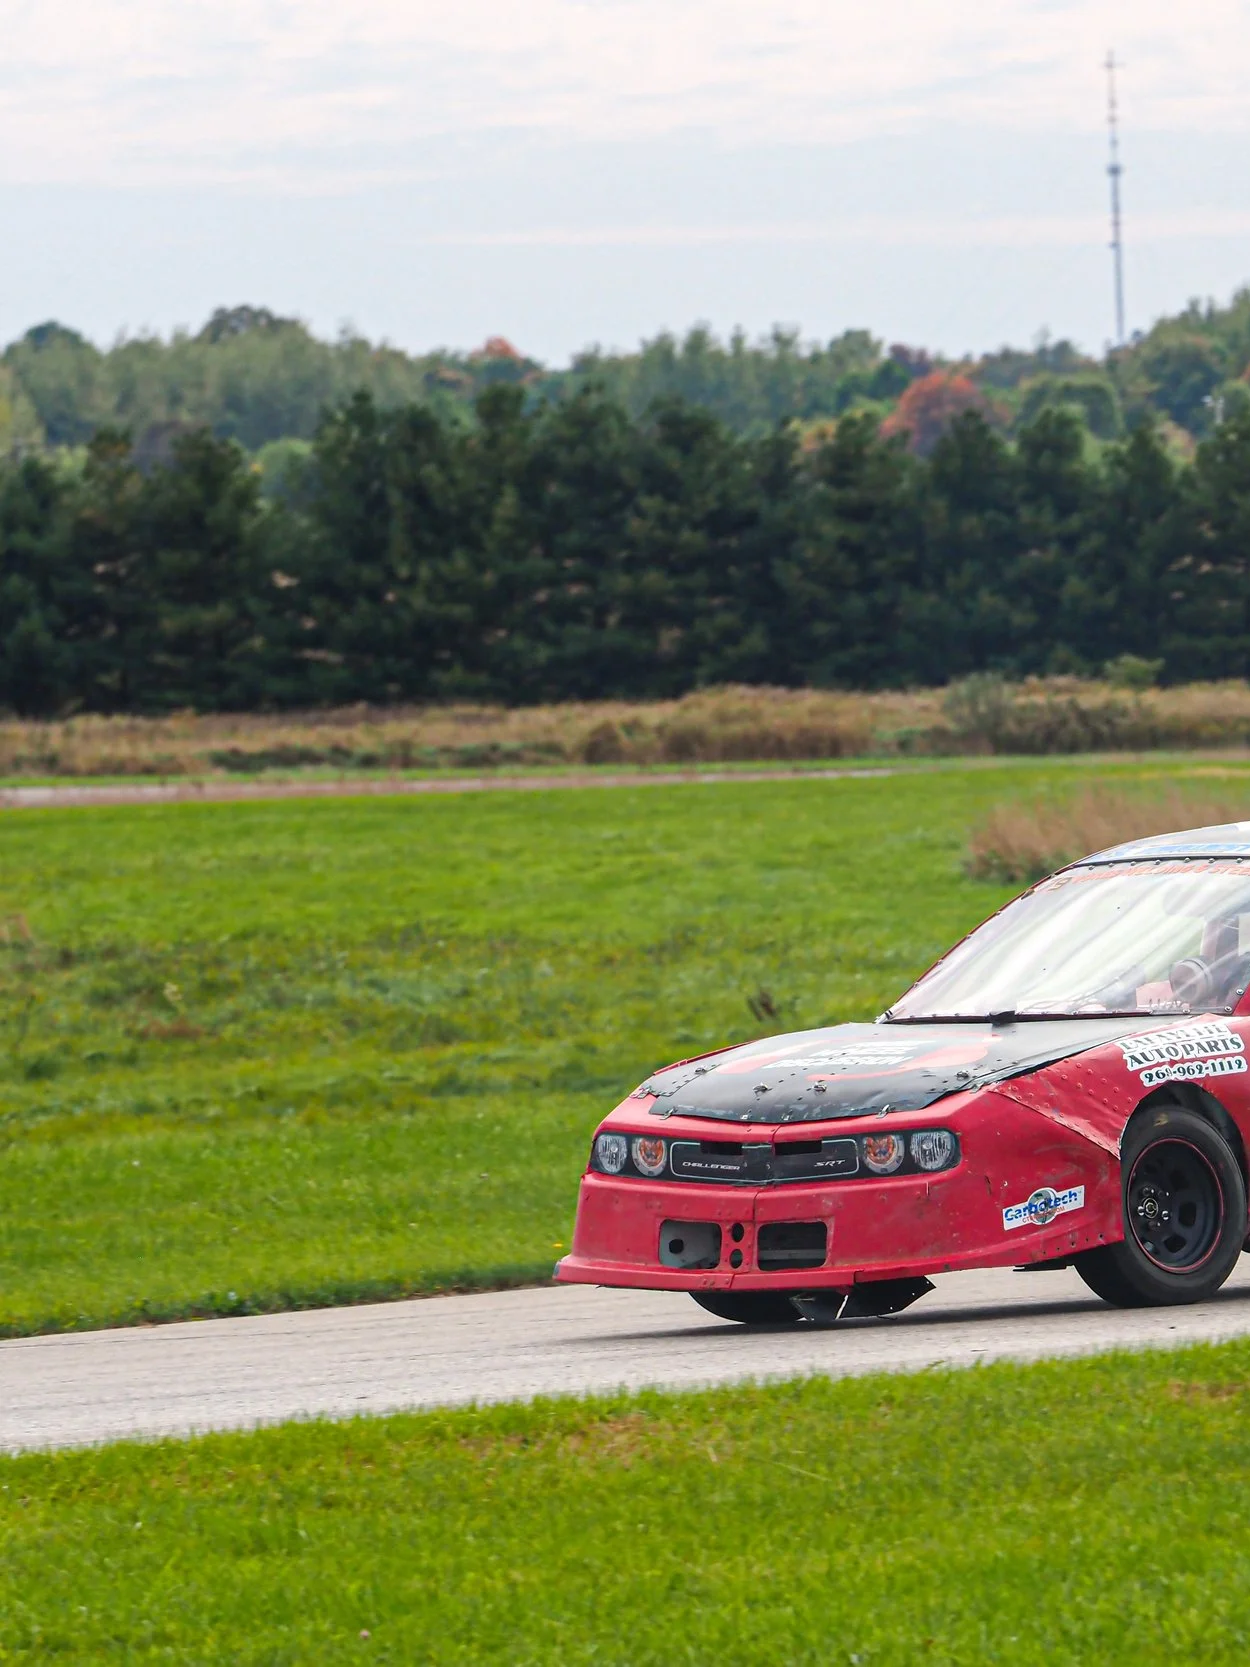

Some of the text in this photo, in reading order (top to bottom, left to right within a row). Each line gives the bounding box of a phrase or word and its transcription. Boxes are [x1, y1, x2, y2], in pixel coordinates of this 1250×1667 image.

[1128, 1036, 1242, 1068] AUTO PARTS
[682, 1159, 846, 1171] CHALLENGER SRT
[1004, 1190, 1078, 1221] Carbotech
